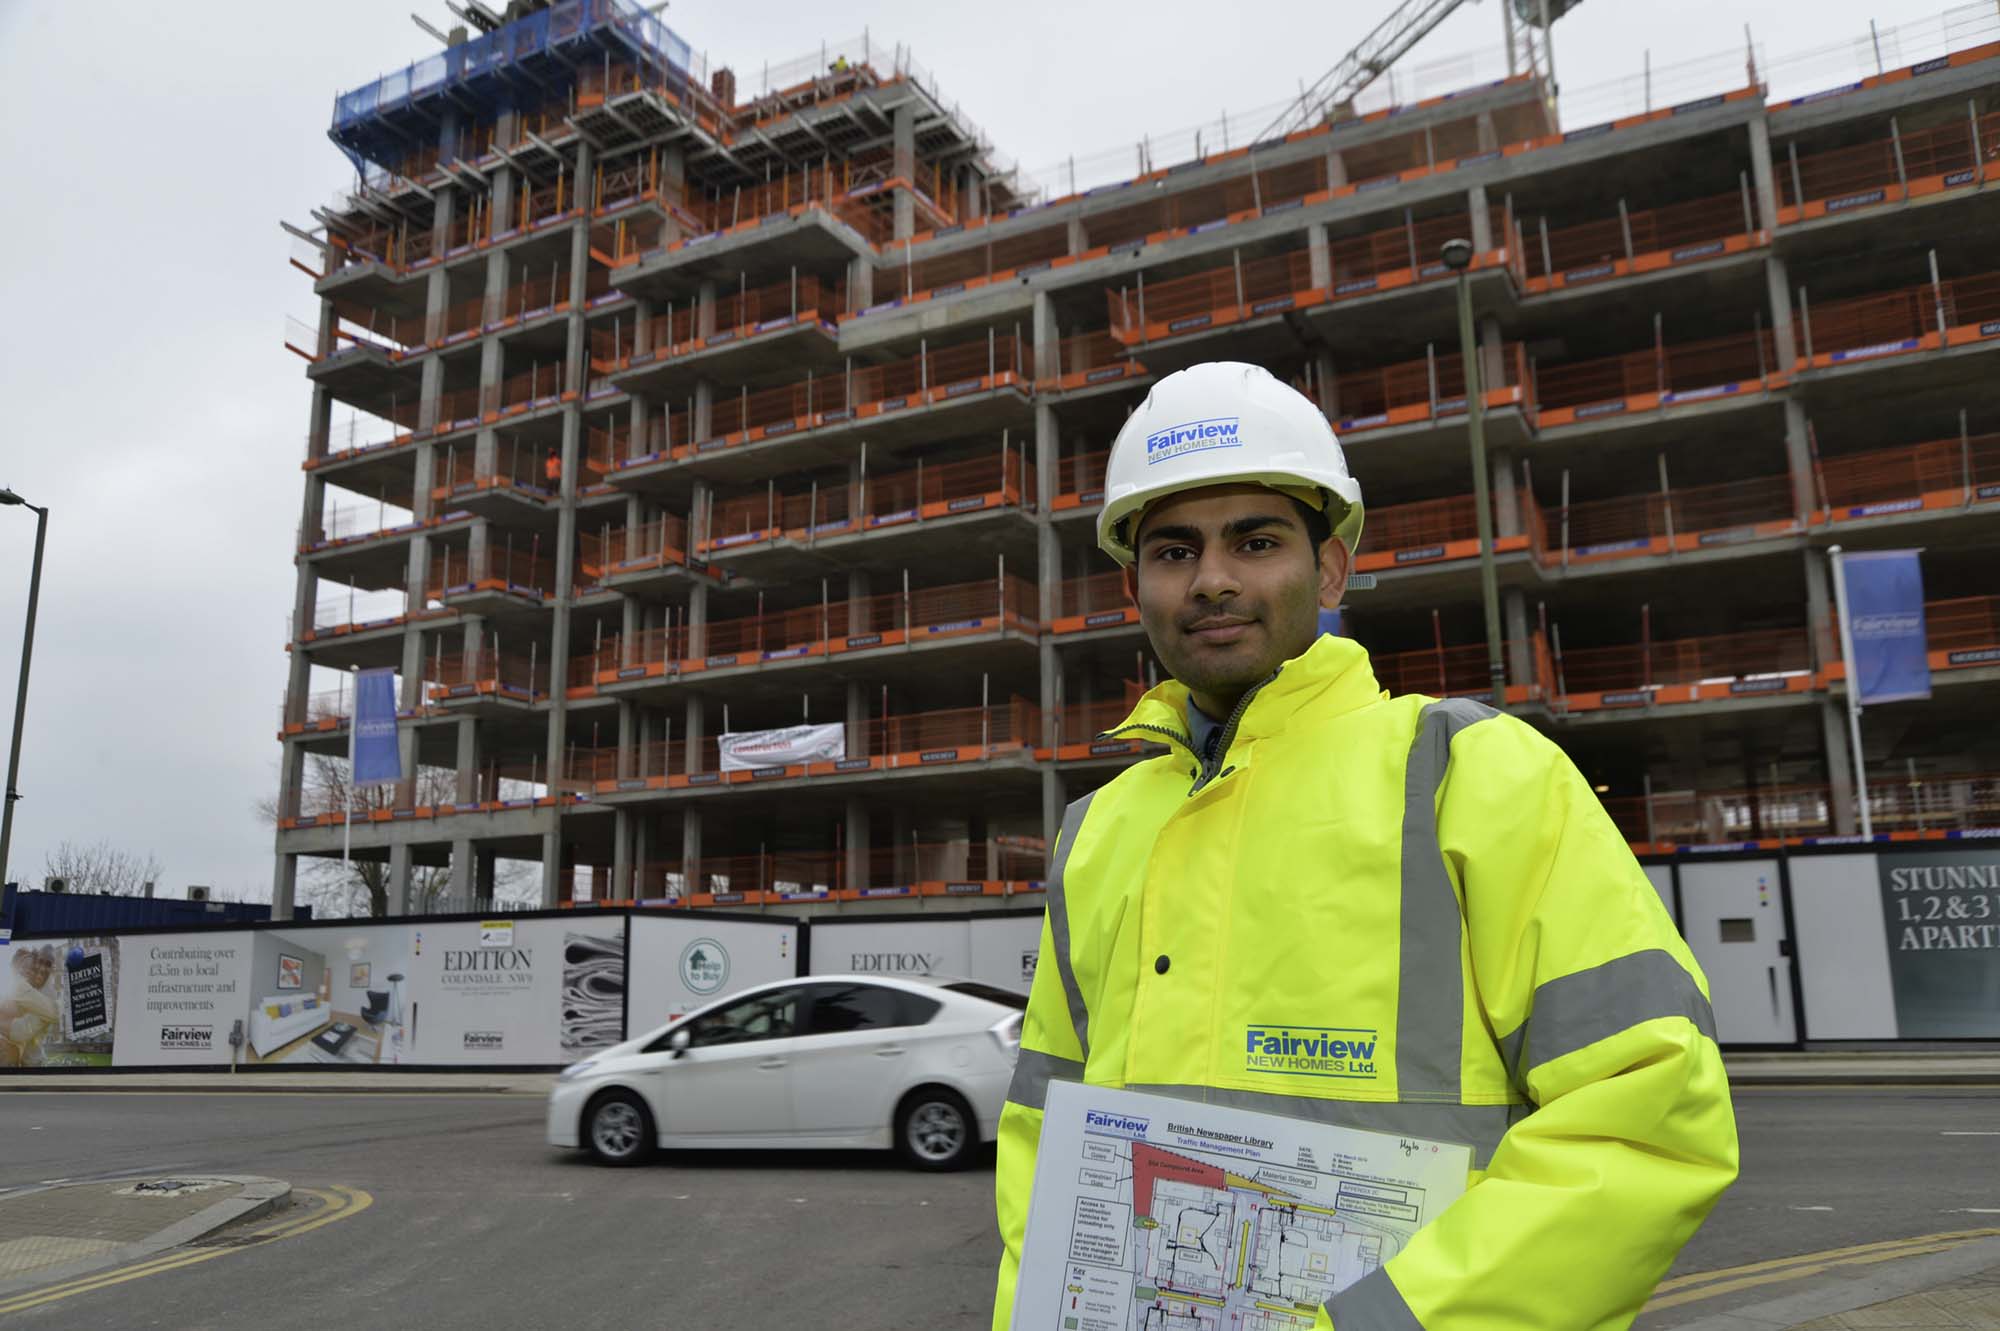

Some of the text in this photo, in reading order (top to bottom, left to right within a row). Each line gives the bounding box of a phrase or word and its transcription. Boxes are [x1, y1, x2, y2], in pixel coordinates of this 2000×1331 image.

[1147, 424, 1239, 453] Fairview
[1149, 436, 1242, 462] NEW HOMES Ltd.
[1899, 925, 2000, 950] APART
[151, 947, 235, 961] Contributing over
[444, 950, 531, 971] EDITION
[851, 954, 931, 971] EDITION
[183, 967, 193, 976] to
[196, 963, 219, 976] local
[148, 979, 236, 993] infrastructure and
[146, 998, 215, 1013] improvements
[161, 1028, 212, 1040] Fairview
[1247, 1031, 1376, 1059] Fairview
[1248, 1055, 1377, 1073] NEW HOMES Ltd.
[1086, 1112, 1148, 1132] Fairview
[1167, 1122, 1274, 1149] British Newspaper Library
[1177, 1137, 1261, 1157] Traffic Management Plan
[1262, 1171, 1313, 1186] Material Storage
